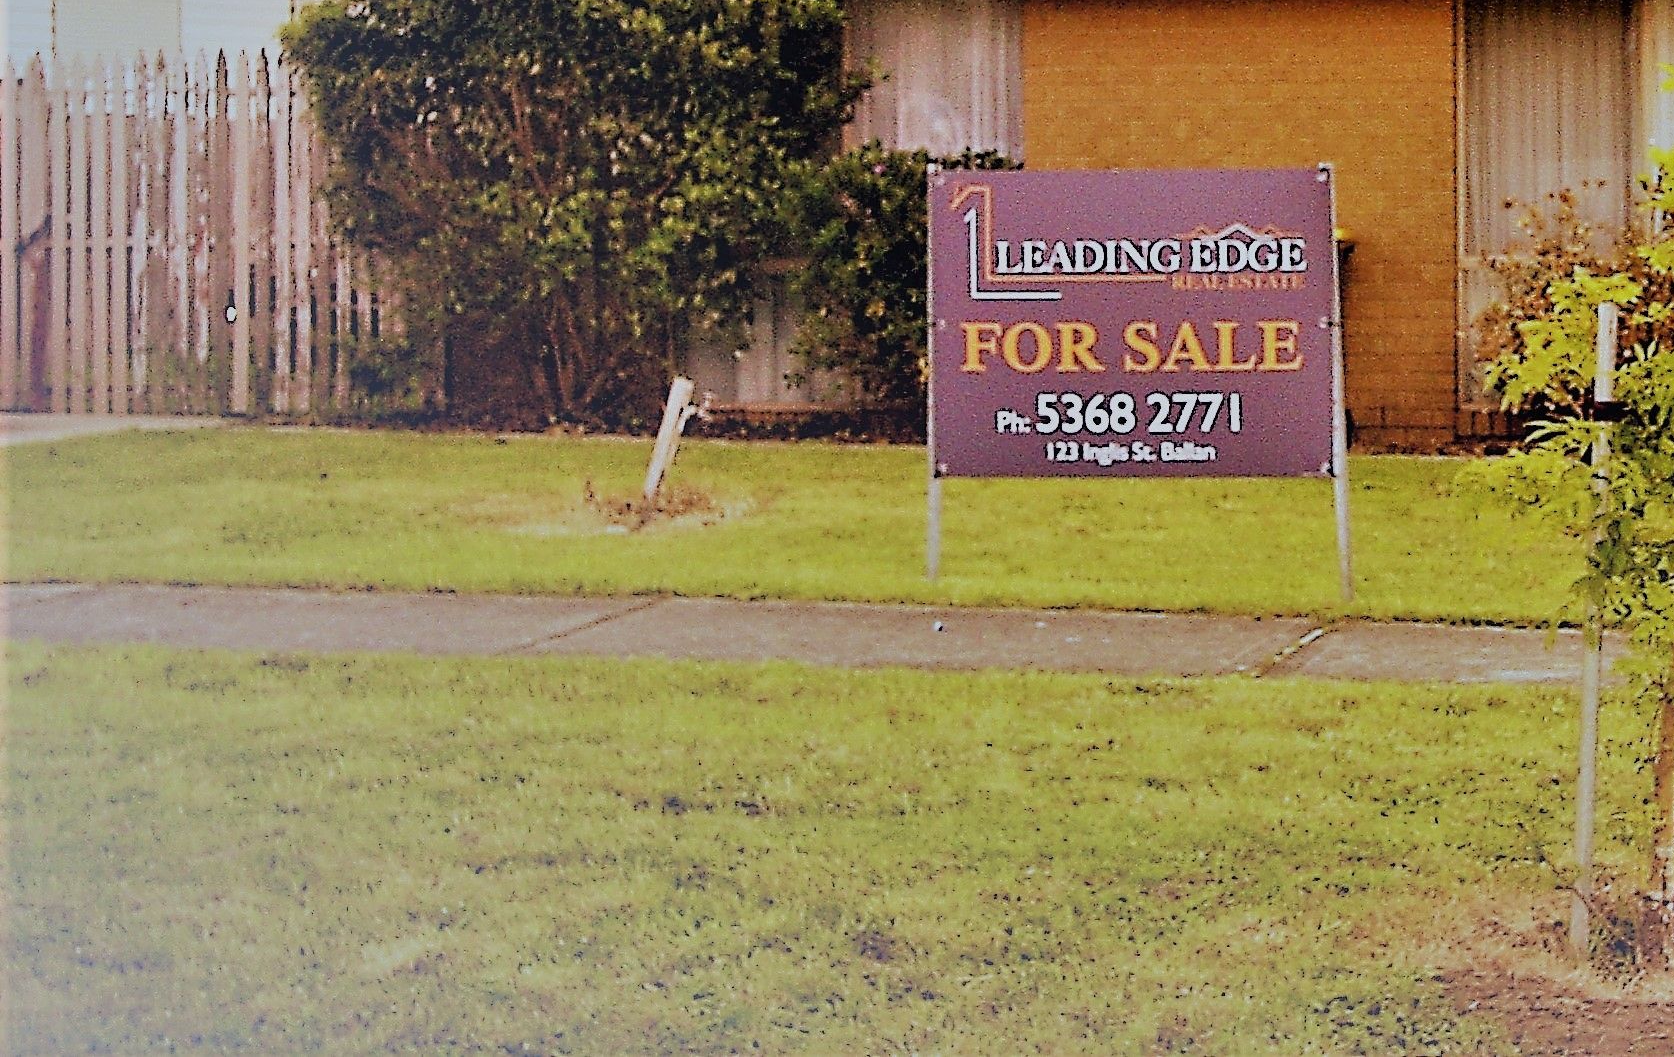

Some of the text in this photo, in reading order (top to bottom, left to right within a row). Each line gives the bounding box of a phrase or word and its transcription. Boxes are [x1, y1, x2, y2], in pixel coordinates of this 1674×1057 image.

[998, 239, 1308, 273] LEADING EDGE
[961, 321, 1303, 372] FOR SALE
[1036, 393, 1137, 434] 5368
[1146, 393, 1242, 433] 2771
[1046, 442, 1079, 461] 123
